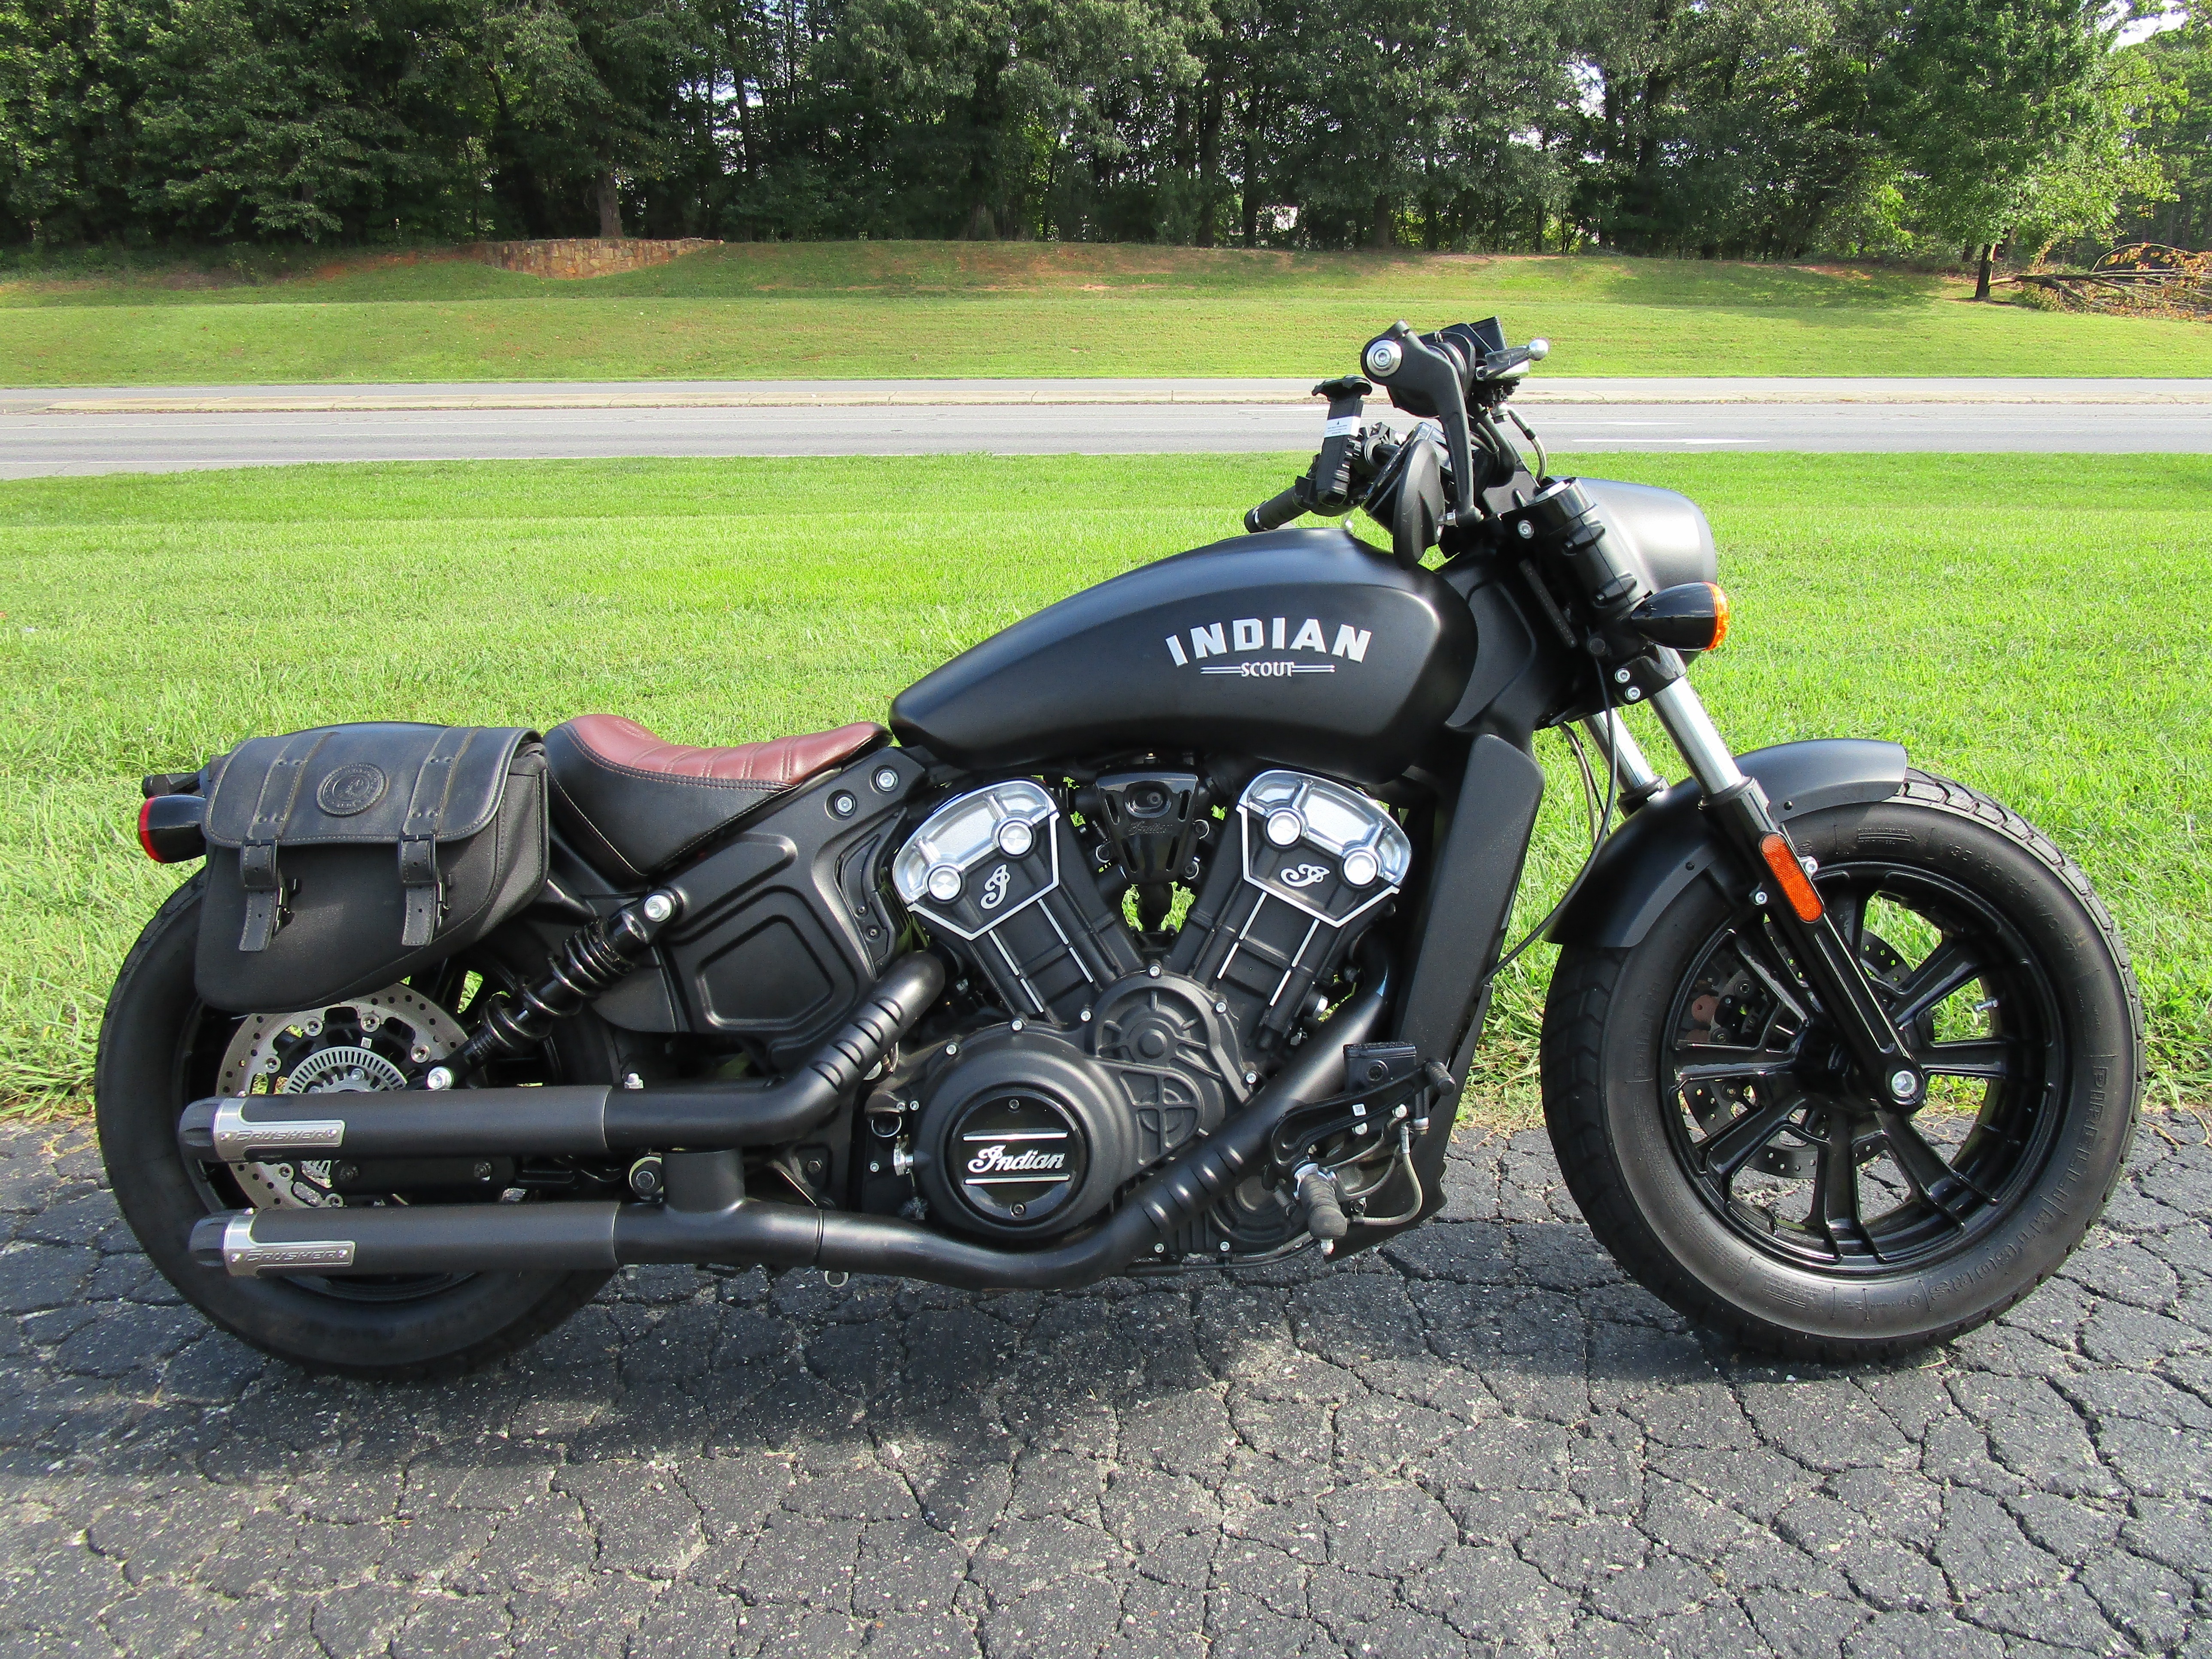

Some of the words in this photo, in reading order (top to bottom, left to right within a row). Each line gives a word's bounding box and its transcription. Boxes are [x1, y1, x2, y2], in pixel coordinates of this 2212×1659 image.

[1165, 617, 1372, 668] INDIAN
[1240, 662, 1294, 678] SCOUT
[967, 1144, 1066, 1173] Indian
